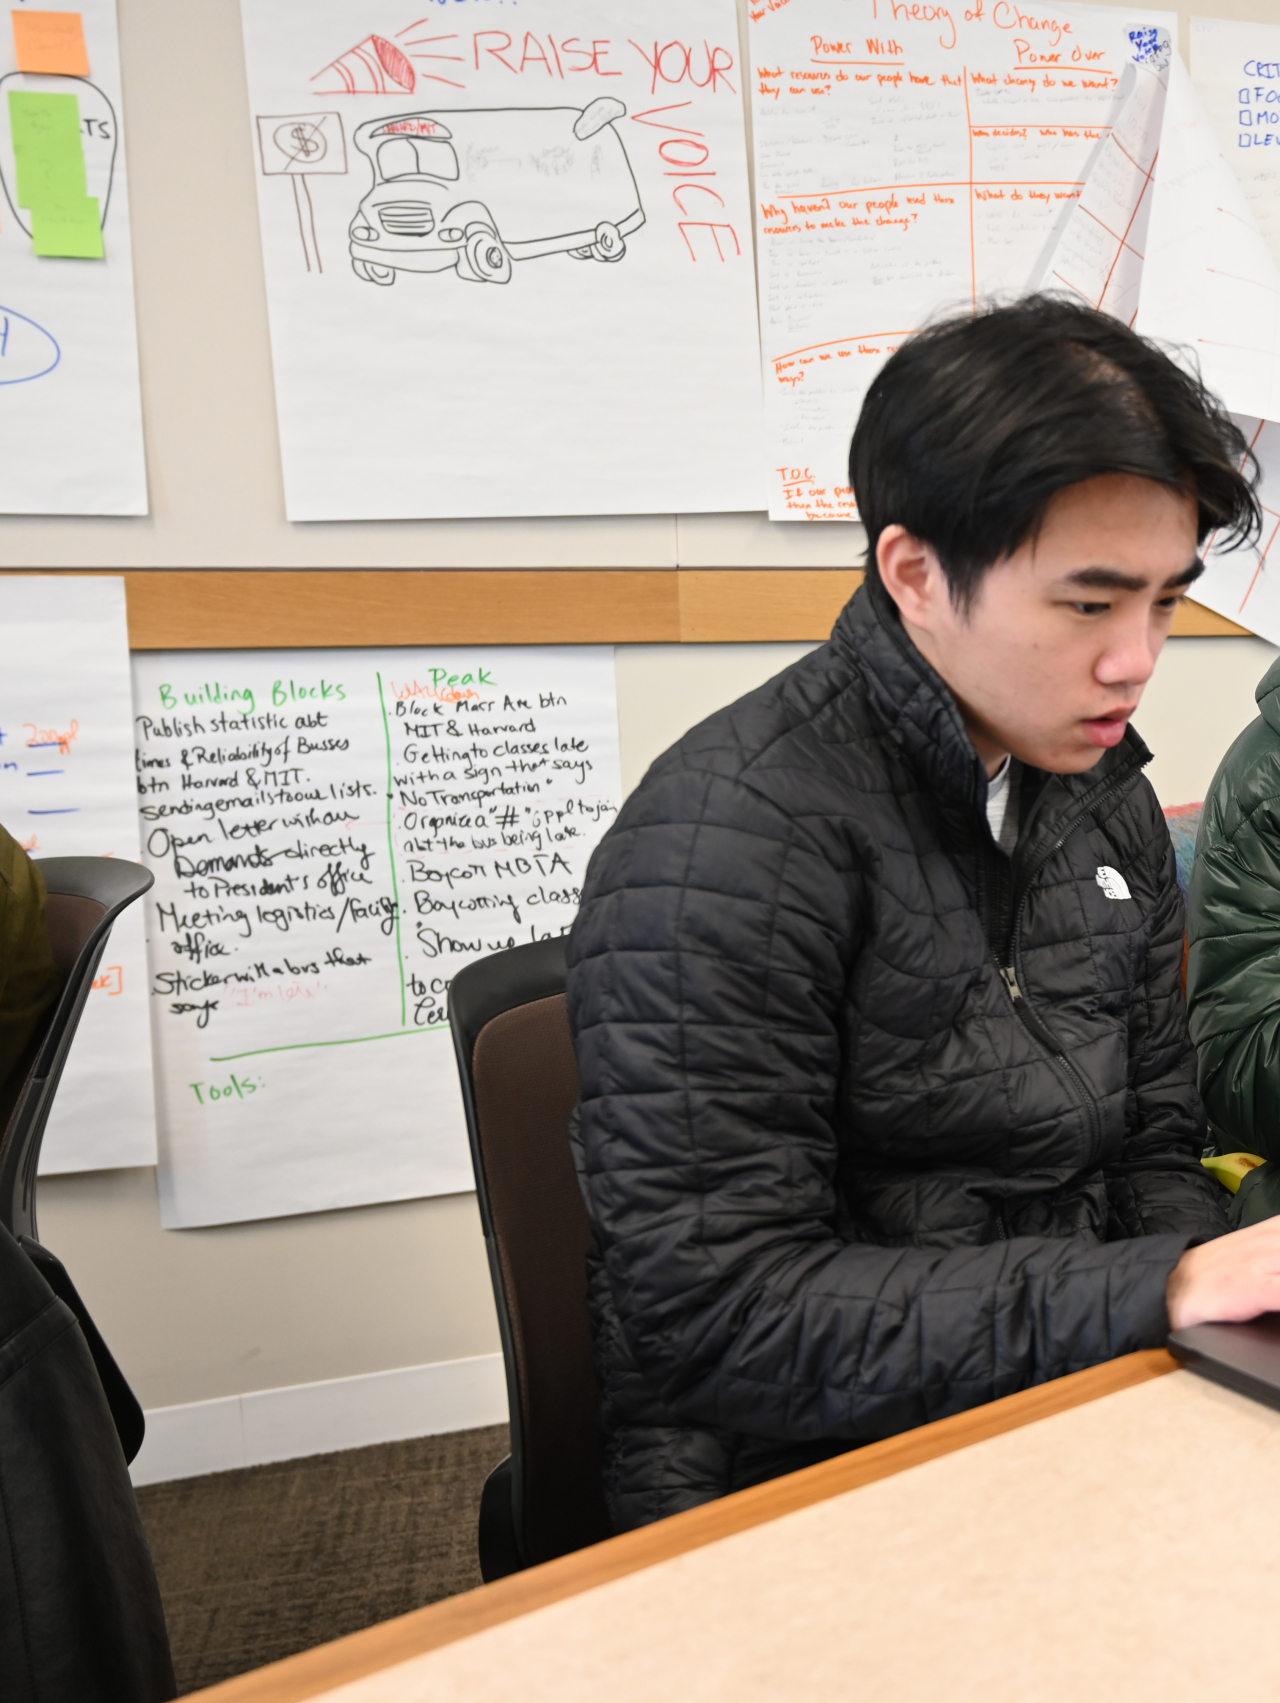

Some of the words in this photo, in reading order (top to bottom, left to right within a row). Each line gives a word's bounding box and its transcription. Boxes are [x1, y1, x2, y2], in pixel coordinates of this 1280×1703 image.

[993, 1, 1074, 47] Change
[810, 34, 852, 55] Power
[866, 38, 904, 55] With
[1014, 38, 1061, 64] Power
[474, 31, 622, 79] RAISE
[627, 38, 737, 95] YOUR
[757, 66, 784, 80] What
[836, 69, 849, 82] do
[855, 73, 872, 82] our
[789, 86, 806, 95] can
[970, 72, 999, 86] What
[1043, 73, 1057, 87] do
[1062, 79, 1078, 87] we
[1082, 77, 1119, 92] want?
[1062, 128, 1080, 138] has
[1084, 130, 1103, 140] the
[630, 101, 741, 263] VOICE
[975, 188, 1006, 202] What
[1011, 189, 1024, 201] do
[761, 203, 789, 225] Why
[838, 199, 859, 210] our
[866, 192, 900, 215] people
[804, 220, 817, 231] to
[820, 217, 847, 230] make
[852, 216, 871, 227] the
[775, 361, 795, 375] How
[799, 357, 815, 365] can
[808, 488, 827, 497] our
[815, 498, 835, 509] the
[427, 666, 499, 688] Peak
[158, 682, 257, 717] Building
[271, 680, 348, 707] Blocks
[395, 699, 445, 718] Block
[538, 691, 568, 709] btn
[135, 714, 207, 741] Publish
[209, 711, 289, 733] statistic
[294, 711, 329, 729] abt
[403, 721, 446, 739] MIT
[445, 719, 464, 737] &
[467, 717, 537, 738] Harvard
[274, 735, 292, 764] of
[469, 741, 489, 759] to
[492, 739, 550, 757] classes
[554, 736, 590, 753] late
[181, 770, 239, 791] Harvard
[245, 767, 262, 789] &
[392, 769, 440, 787] with
[442, 770, 458, 781] a
[463, 763, 503, 786] sign
[551, 758, 594, 785] says
[474, 814, 490, 828] a
[147, 827, 213, 858] Open
[217, 818, 279, 841] letter
[493, 852, 573, 880] MBTA
[183, 880, 210, 899] to
[405, 972, 428, 997] to
